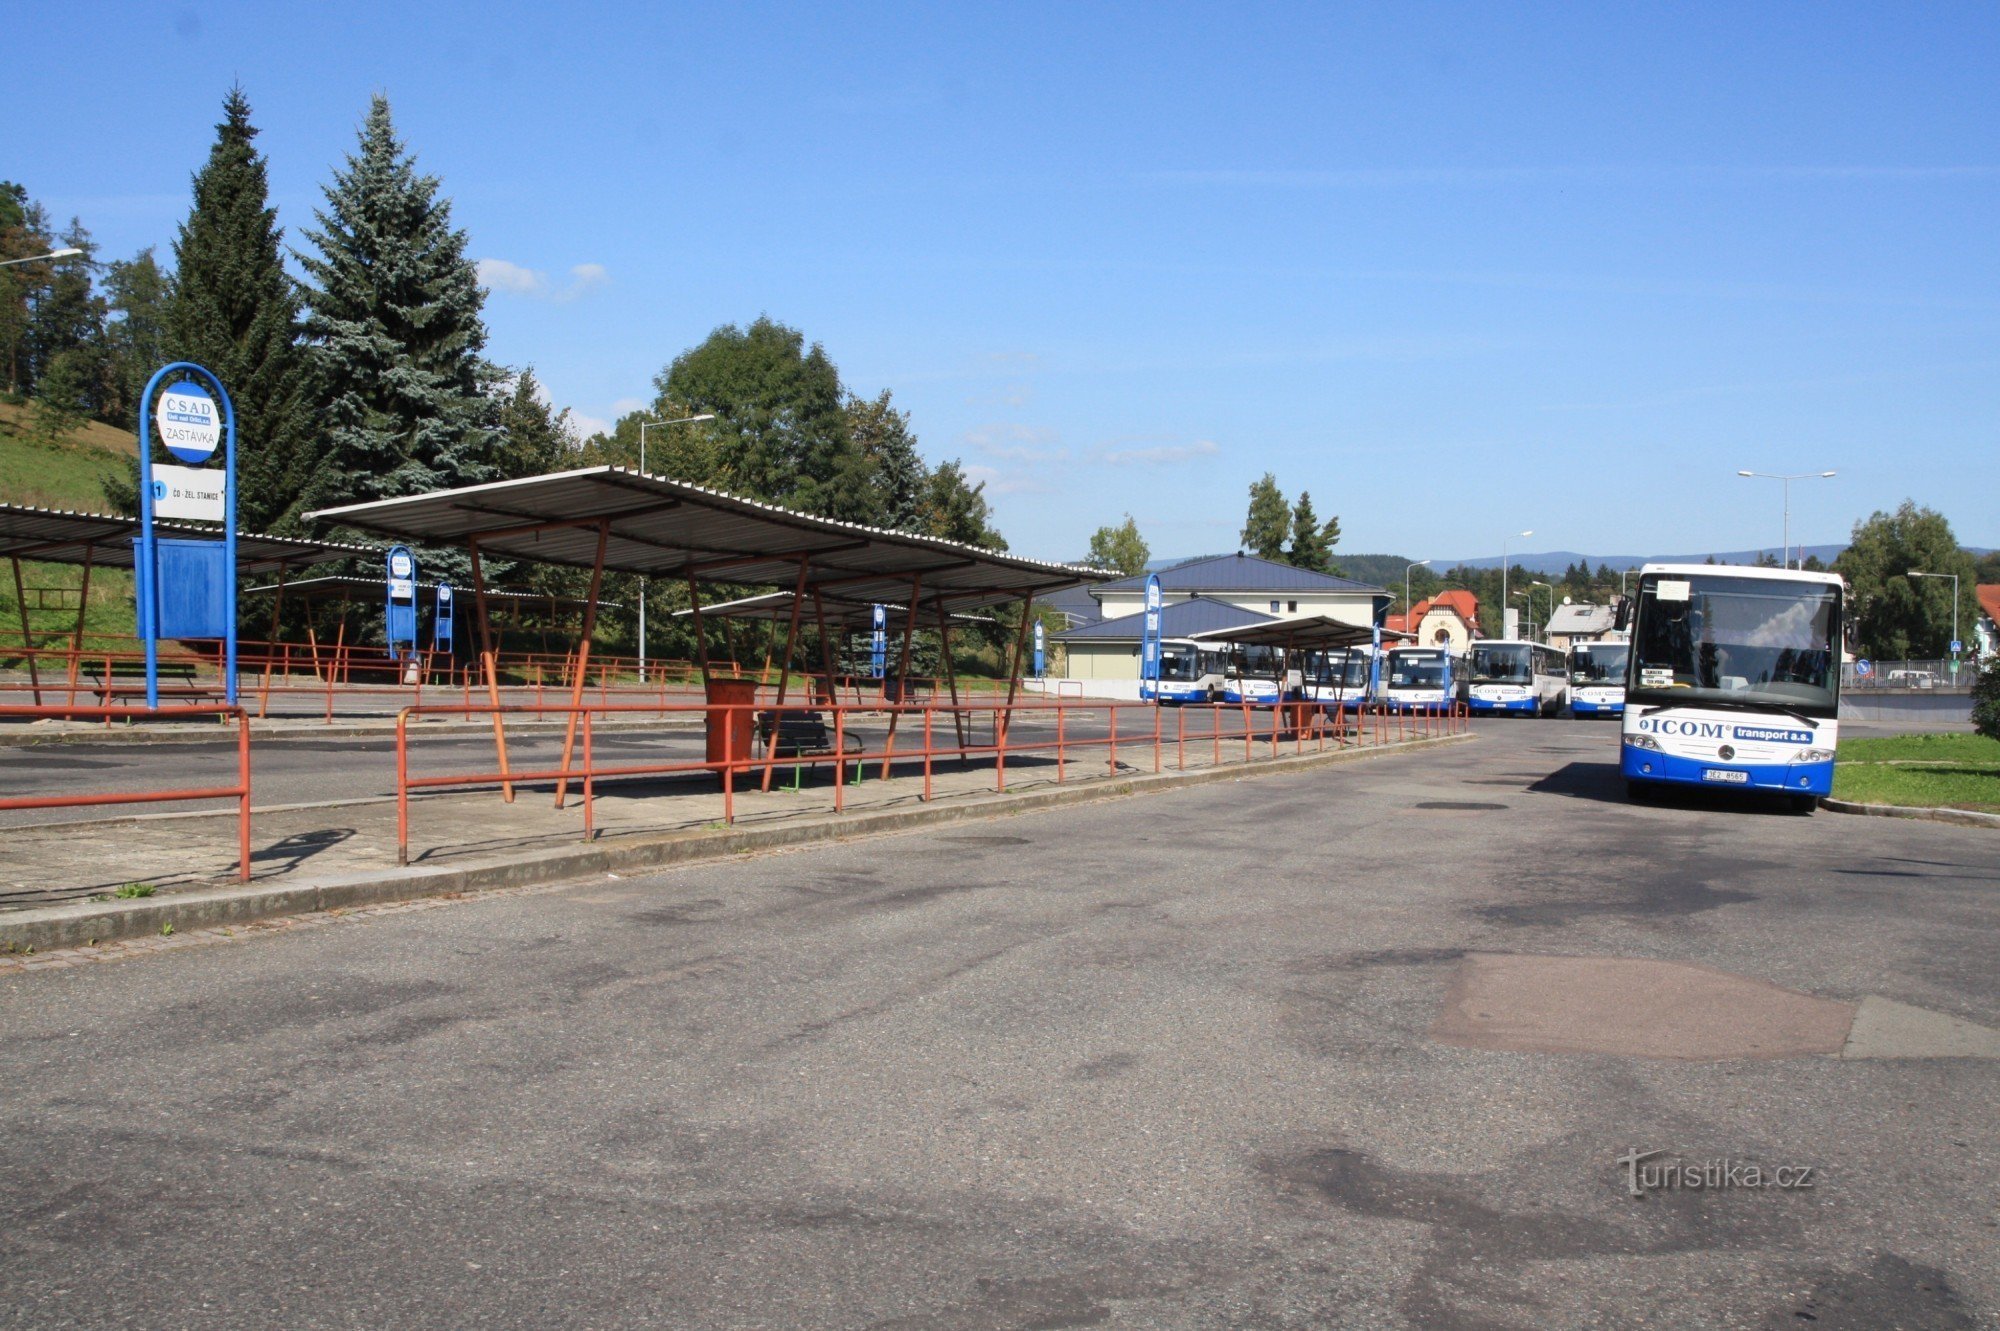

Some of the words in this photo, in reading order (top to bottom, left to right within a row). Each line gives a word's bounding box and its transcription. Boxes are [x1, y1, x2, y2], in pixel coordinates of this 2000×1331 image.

[156, 485, 161, 497] 1
[196, 491, 219, 501] STANICE
[1737, 727, 1788, 742] transport
[1790, 730, 1810, 742] a.s.
